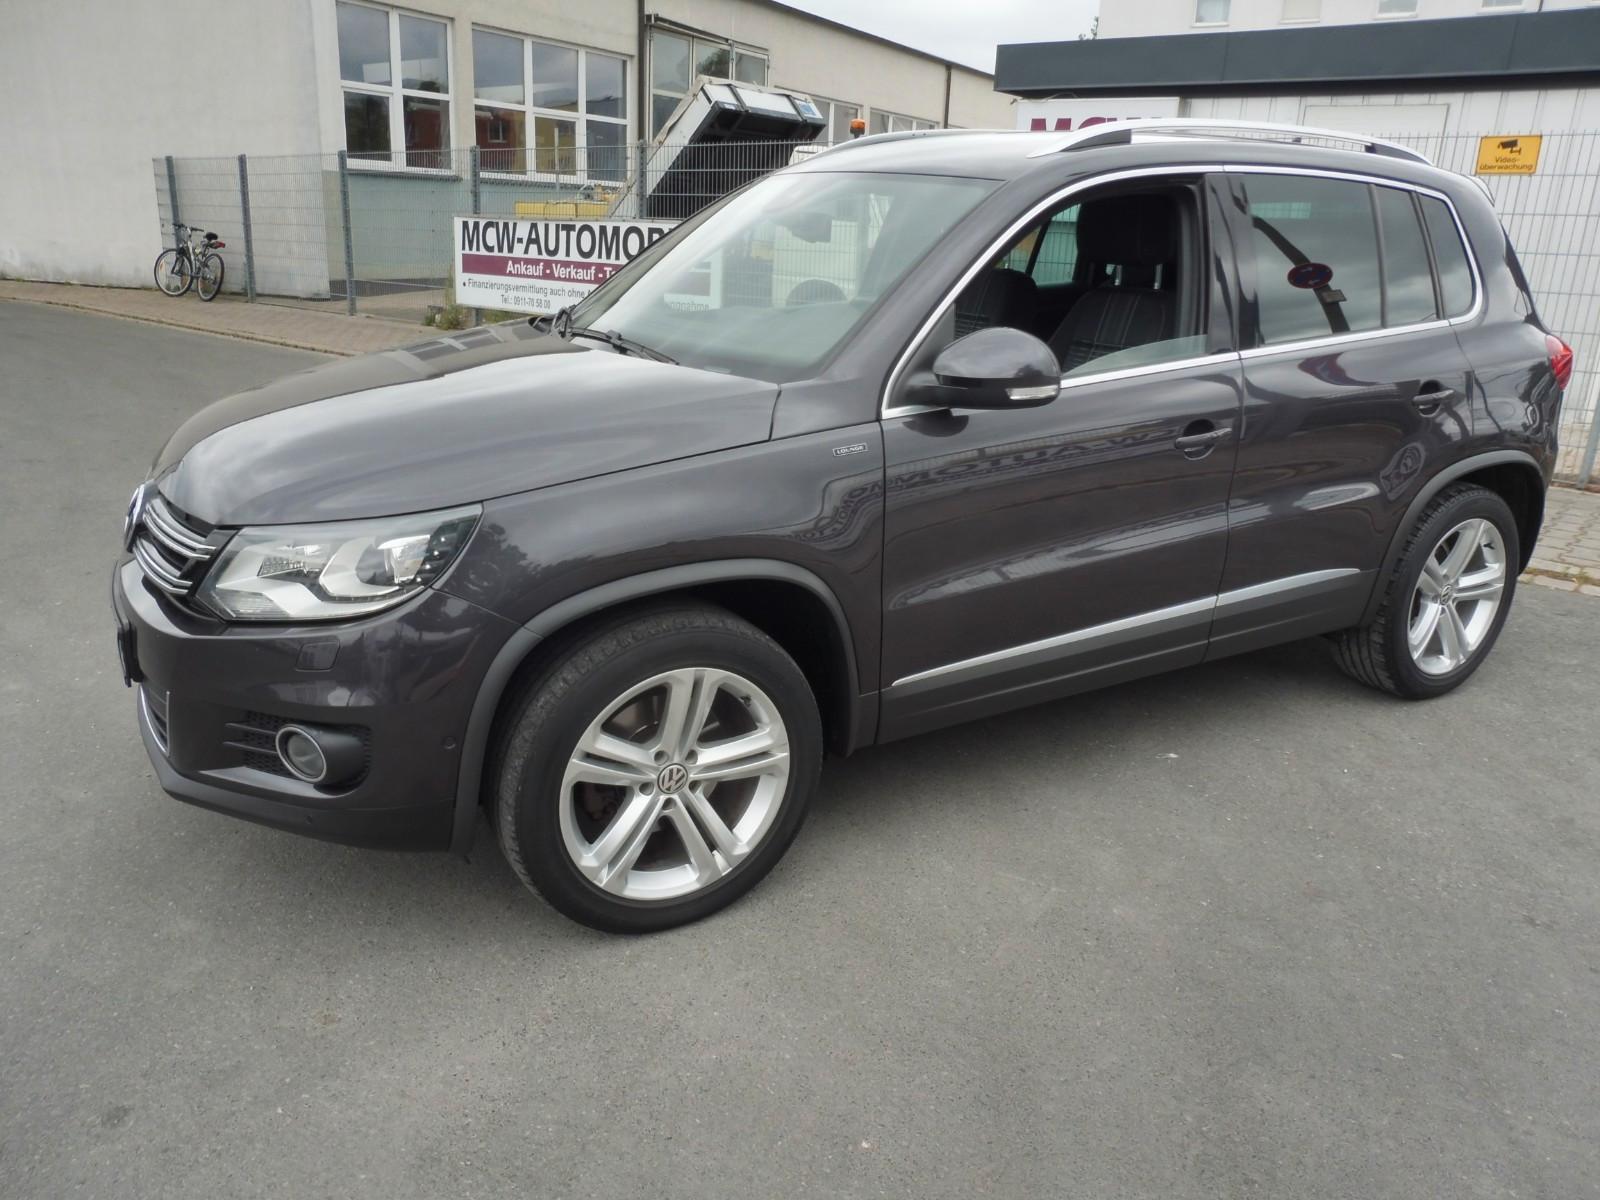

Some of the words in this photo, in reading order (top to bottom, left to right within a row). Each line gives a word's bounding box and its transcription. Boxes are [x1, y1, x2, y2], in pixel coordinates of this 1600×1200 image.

[461, 220, 673, 262] MCW-AUTOMO
[506, 260, 544, 276] Ankauf
[552, 263, 596, 281] Verkauf
[468, 278, 548, 297] Finanzierungsvermittlung
[549, 287, 566, 297] auch
[567, 288, 585, 298] ohne
